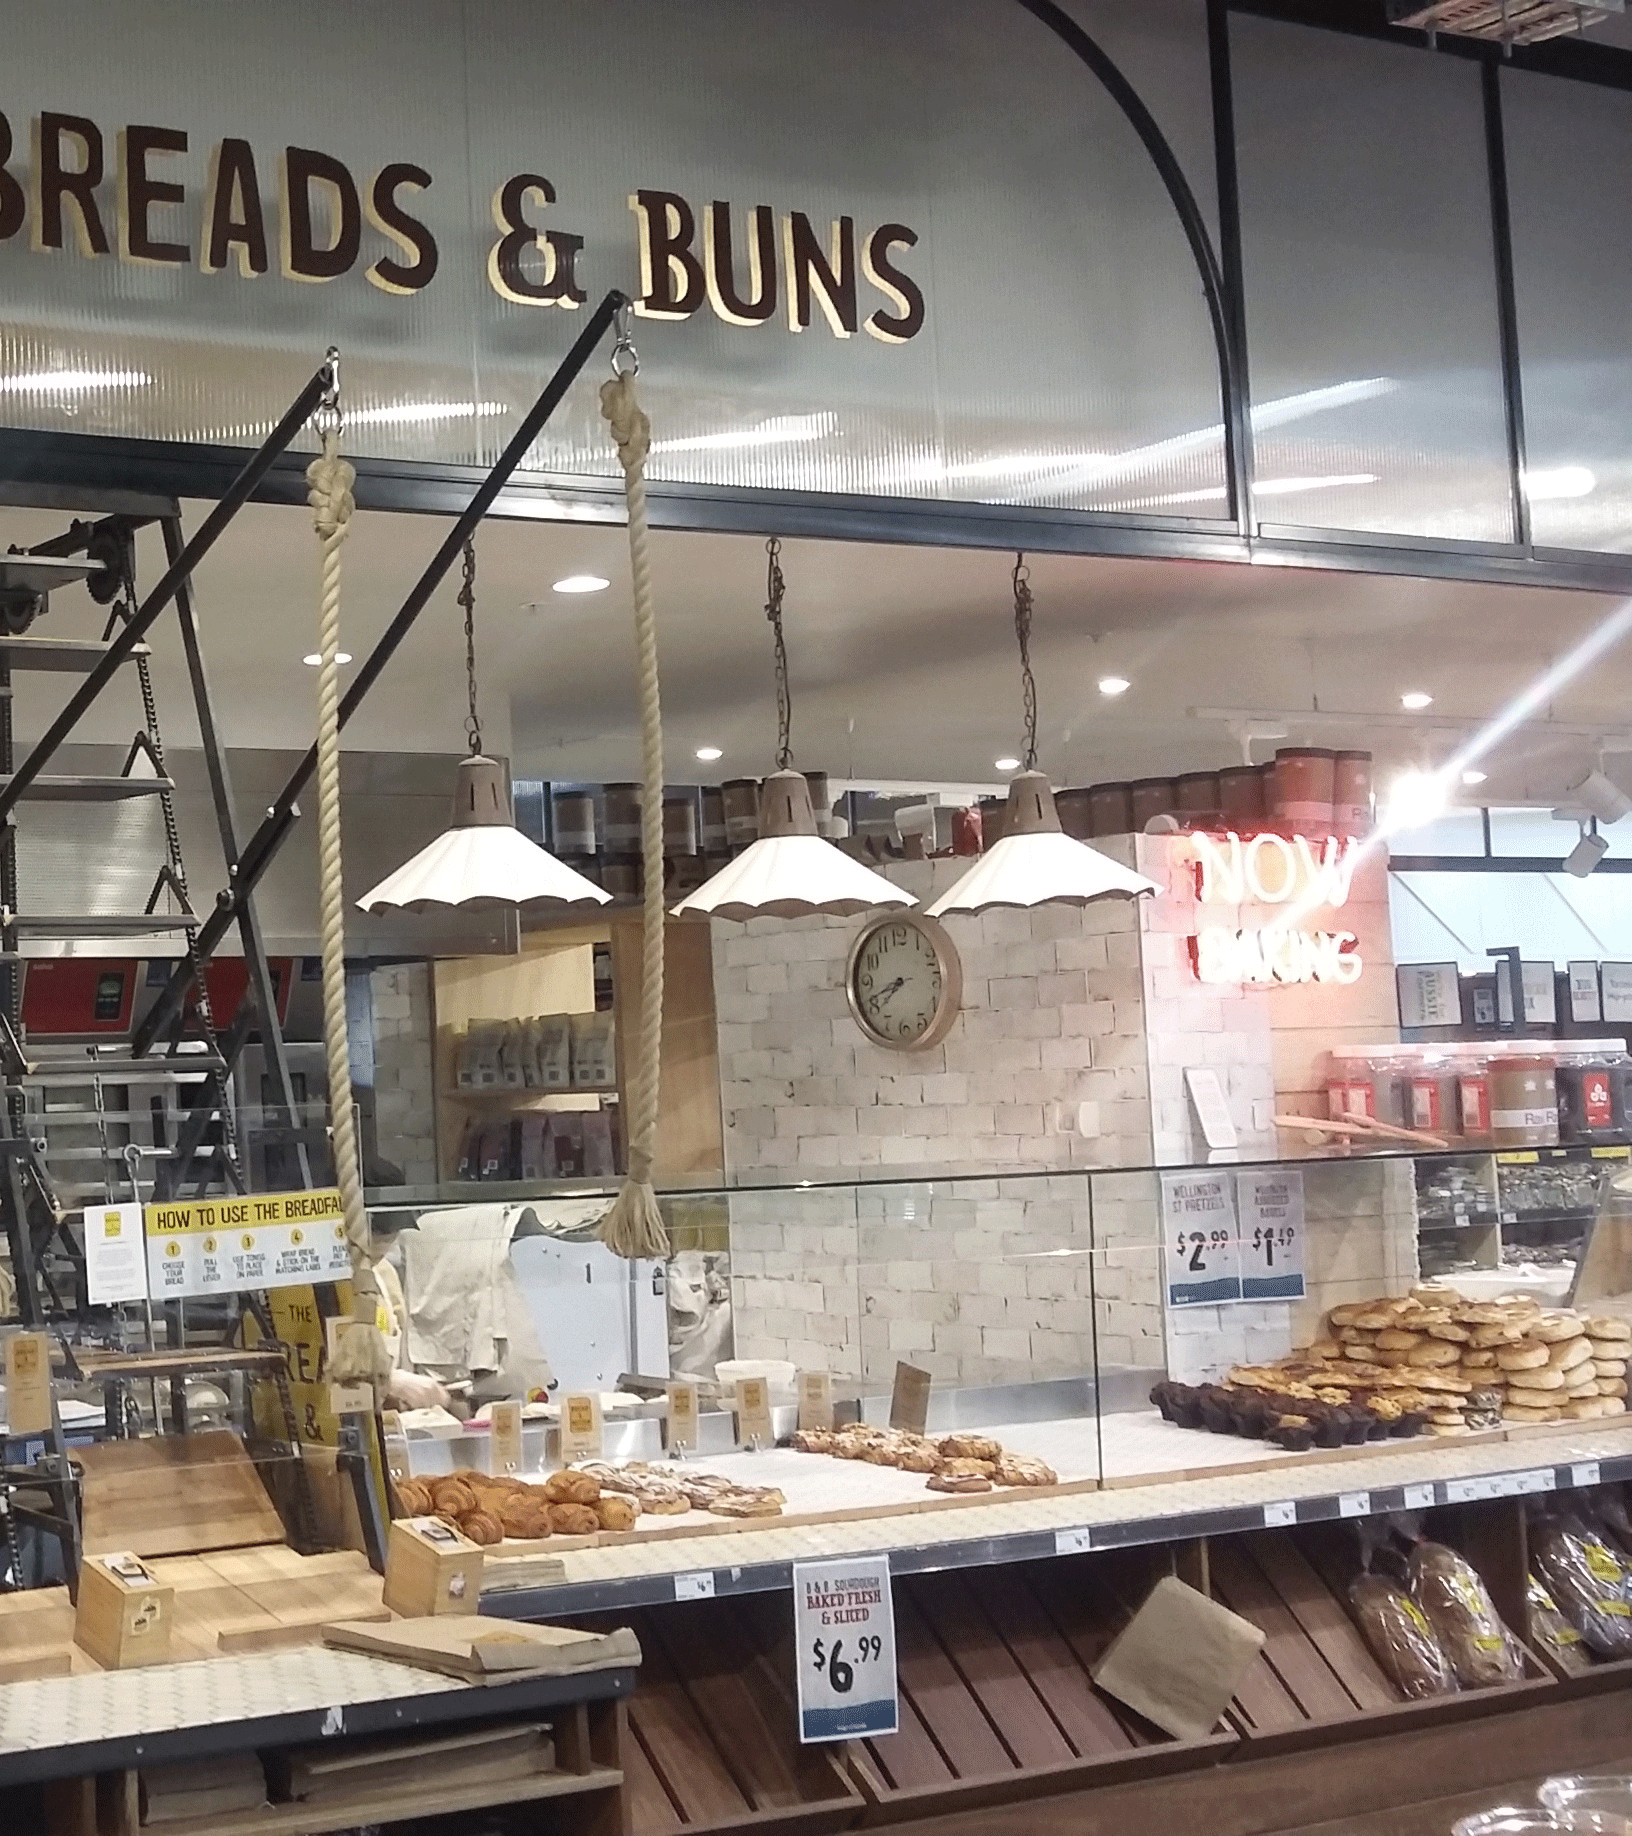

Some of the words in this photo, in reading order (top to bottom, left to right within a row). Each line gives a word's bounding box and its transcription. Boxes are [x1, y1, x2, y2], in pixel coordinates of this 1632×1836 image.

[490, 174, 586, 307] &
[630, 189, 926, 342] BUNS
[1191, 830, 1358, 907] NOW
[892, 927, 907, 947] 12
[157, 1209, 190, 1229] HOW
[196, 1207, 215, 1226] TO
[221, 1205, 249, 1223] USE
[254, 1202, 279, 1220] THE
[285, 1196, 343, 1218] BREADFAL
[289, 1305, 312, 1323] THE
[305, 1403, 324, 1441] &
[807, 1593, 845, 1609] BAKED
[847, 1589, 882, 1606] FRESH
[822, 1611, 831, 1625] &
[834, 1608, 869, 1624] SLICED
[812, 1635, 882, 1694] $6.99
